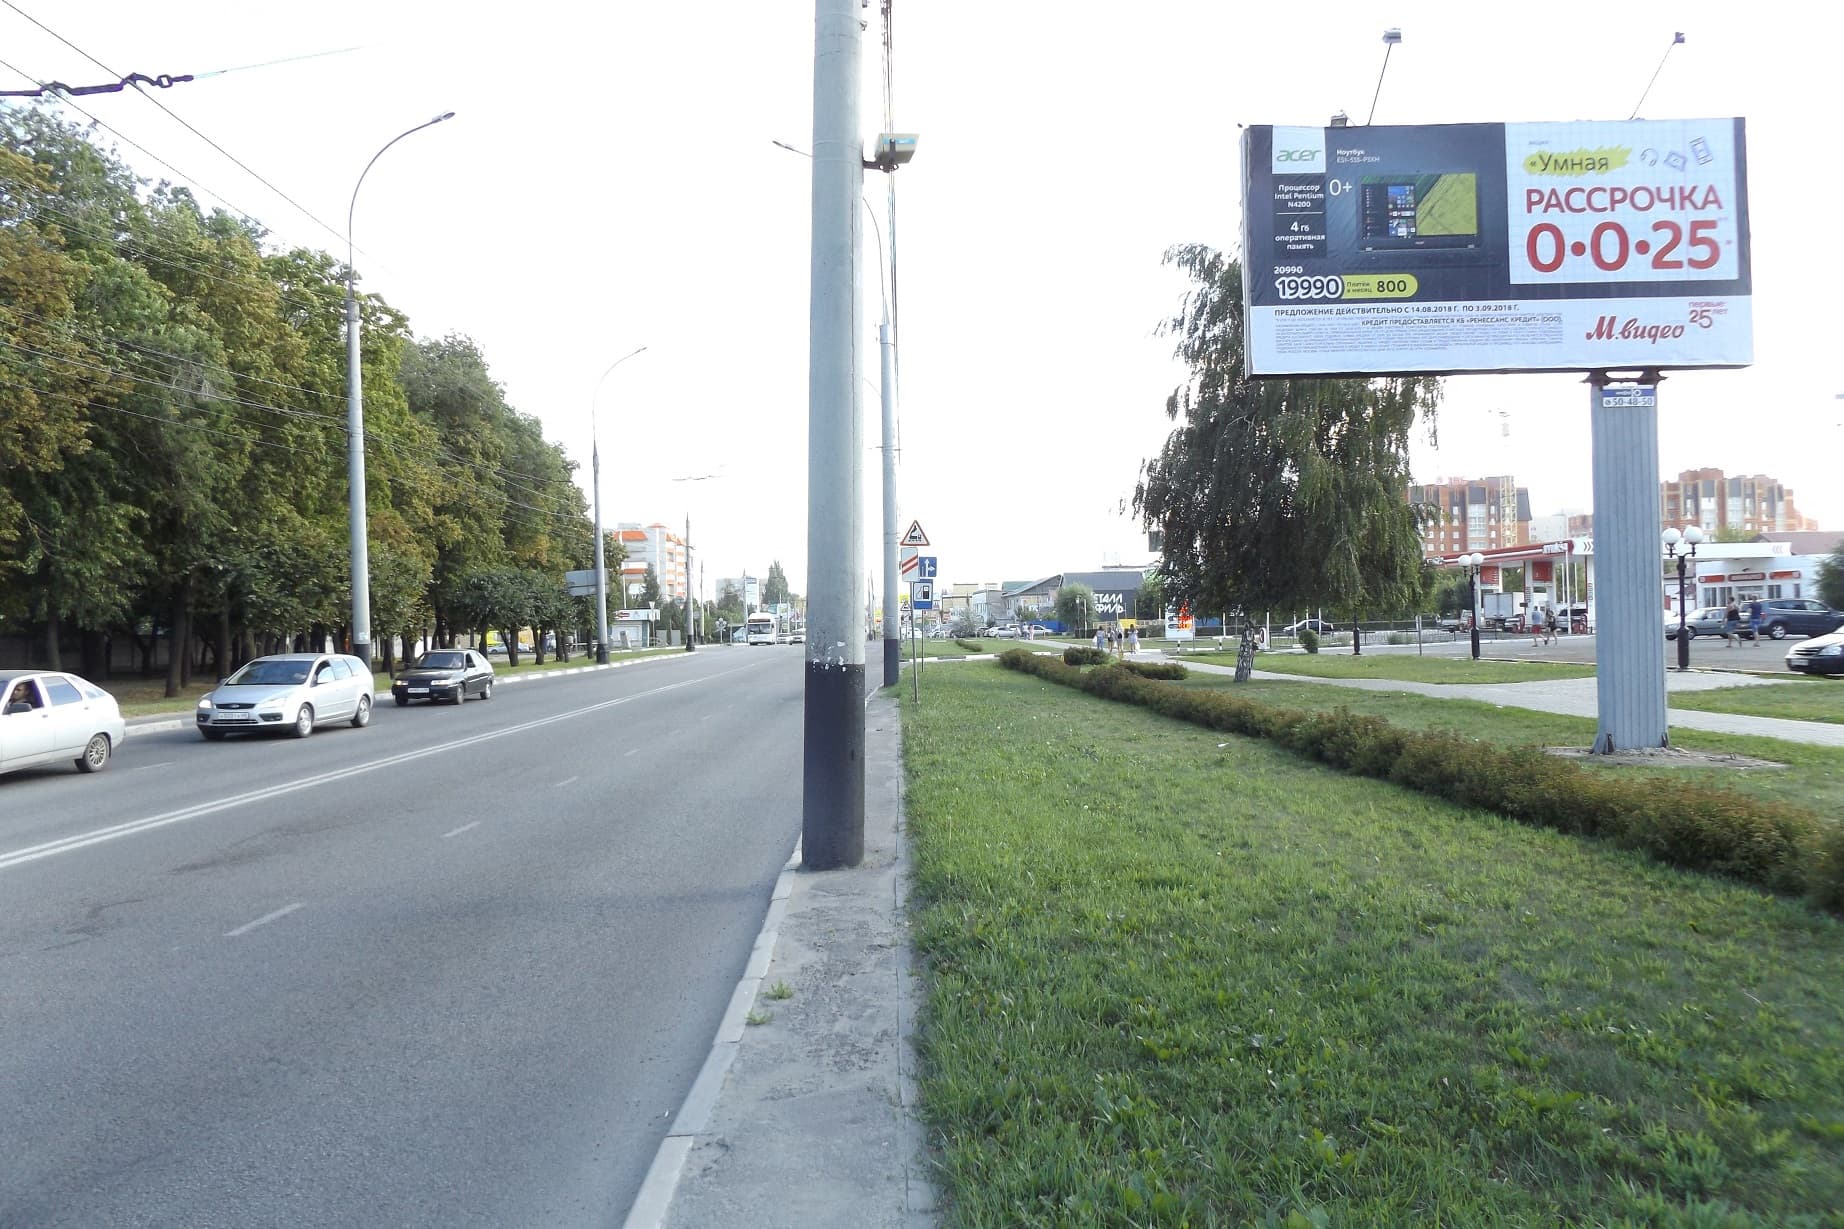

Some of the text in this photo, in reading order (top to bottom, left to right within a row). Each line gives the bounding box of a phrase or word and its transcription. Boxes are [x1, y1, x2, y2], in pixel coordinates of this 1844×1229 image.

[1277, 150, 1322, 162] acer
[1336, 148, 1365, 157] Ноутбук
[1530, 154, 1609, 171] «Умная
[1278, 184, 1320, 193] Процессор
[1329, 179, 1353, 196] 0+
[1526, 184, 1724, 214] РАССРОЧКА
[1290, 221, 1299, 232] 4
[1275, 234, 1326, 243] оперативная
[1274, 266, 1303, 274] 20990
[1276, 277, 1341, 298] 19990
[1376, 280, 1407, 293] 800
[1274, 308, 1334, 317] ПРЕДЛОЖЕНИЕ
[1335, 307, 1403, 315] ДЕЙСТВИТЕЛЬНО
[1410, 305, 1453, 313] 14.08.2018
[1475, 304, 1512, 312] 3.09.2018
[1389, 318, 1455, 326] ПРЕДОСТАВЛЯЕТСЯ
[1689, 309, 1713, 329] 25
[1585, 315, 1685, 345] М.видео
[1092, 593, 1123, 603] ЕТАЛЛ
